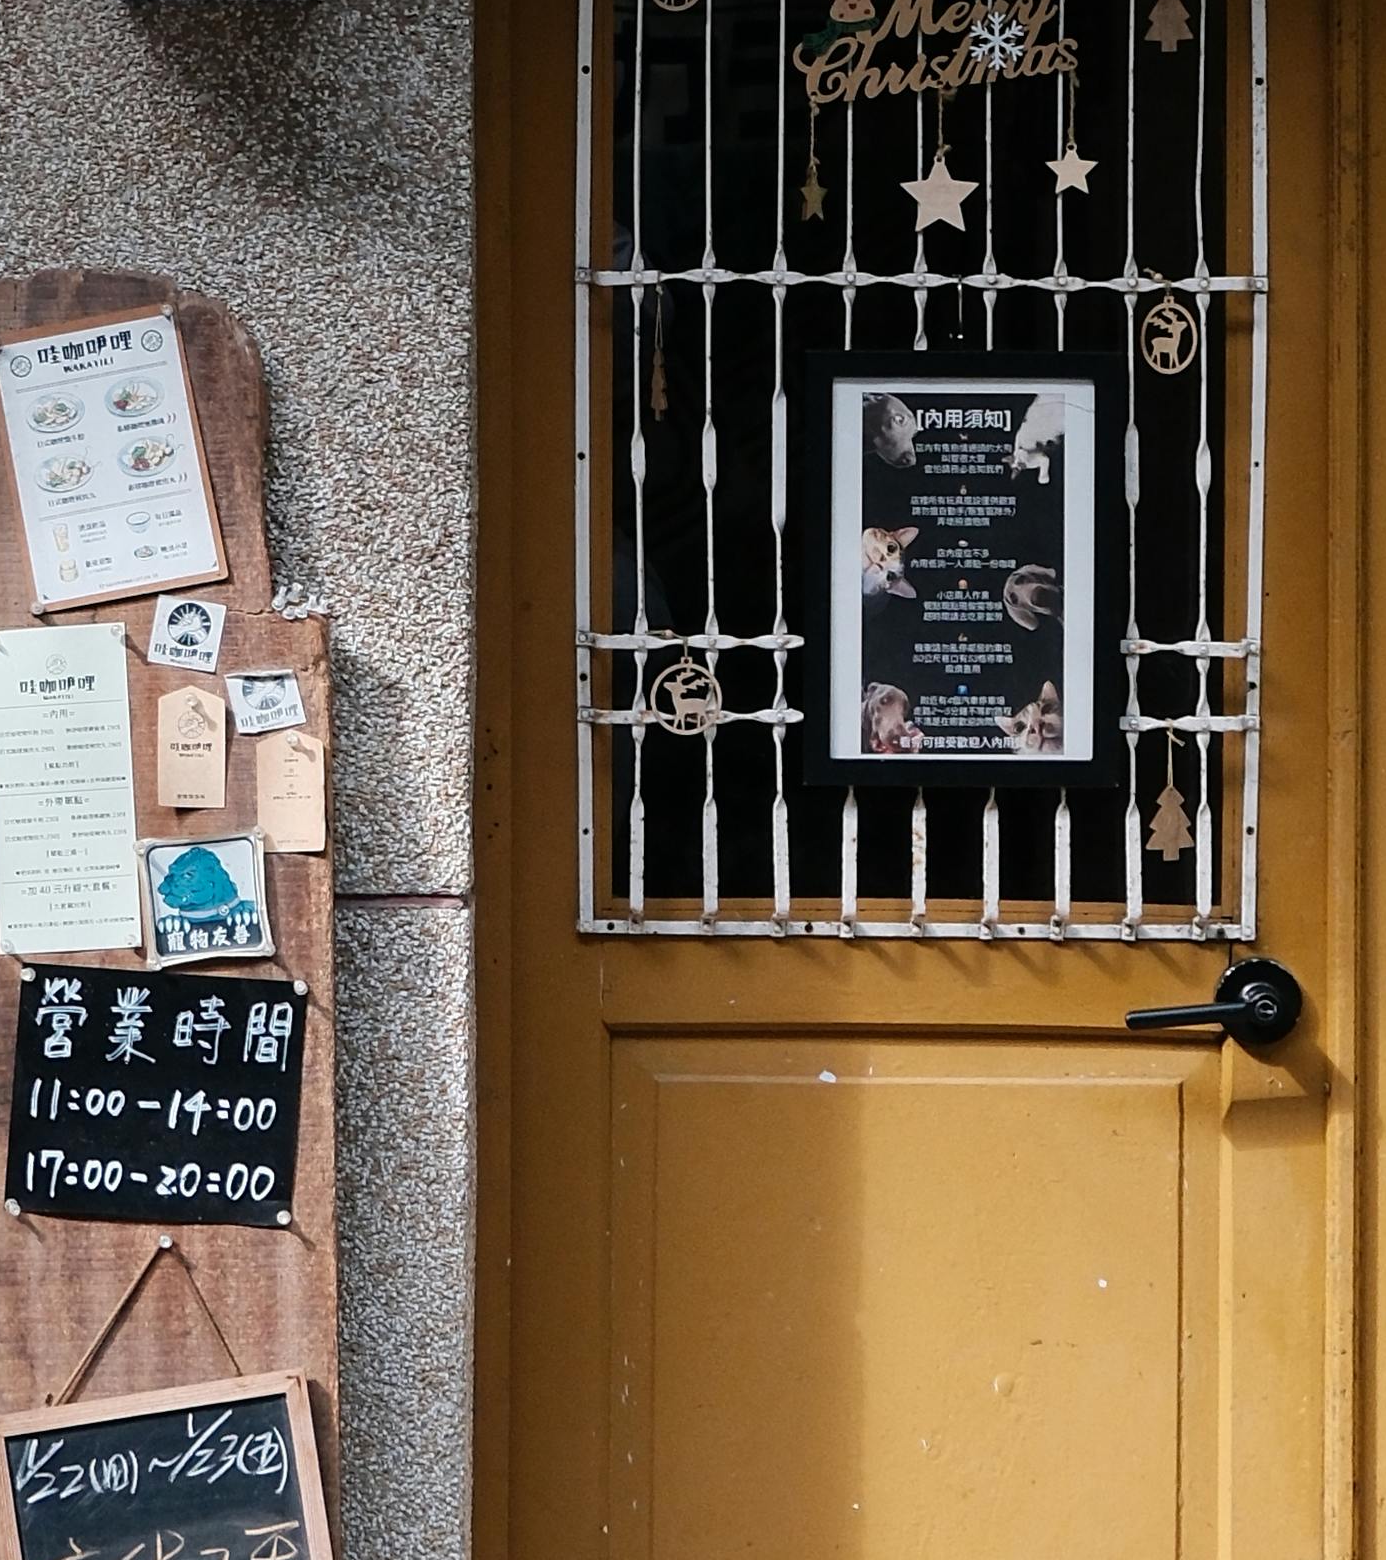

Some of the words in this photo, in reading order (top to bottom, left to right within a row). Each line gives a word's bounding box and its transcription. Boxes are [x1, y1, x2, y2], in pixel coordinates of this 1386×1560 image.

[166, 927, 252, 953] 寵物友善
[35, 977, 293, 1073] 營業時間
